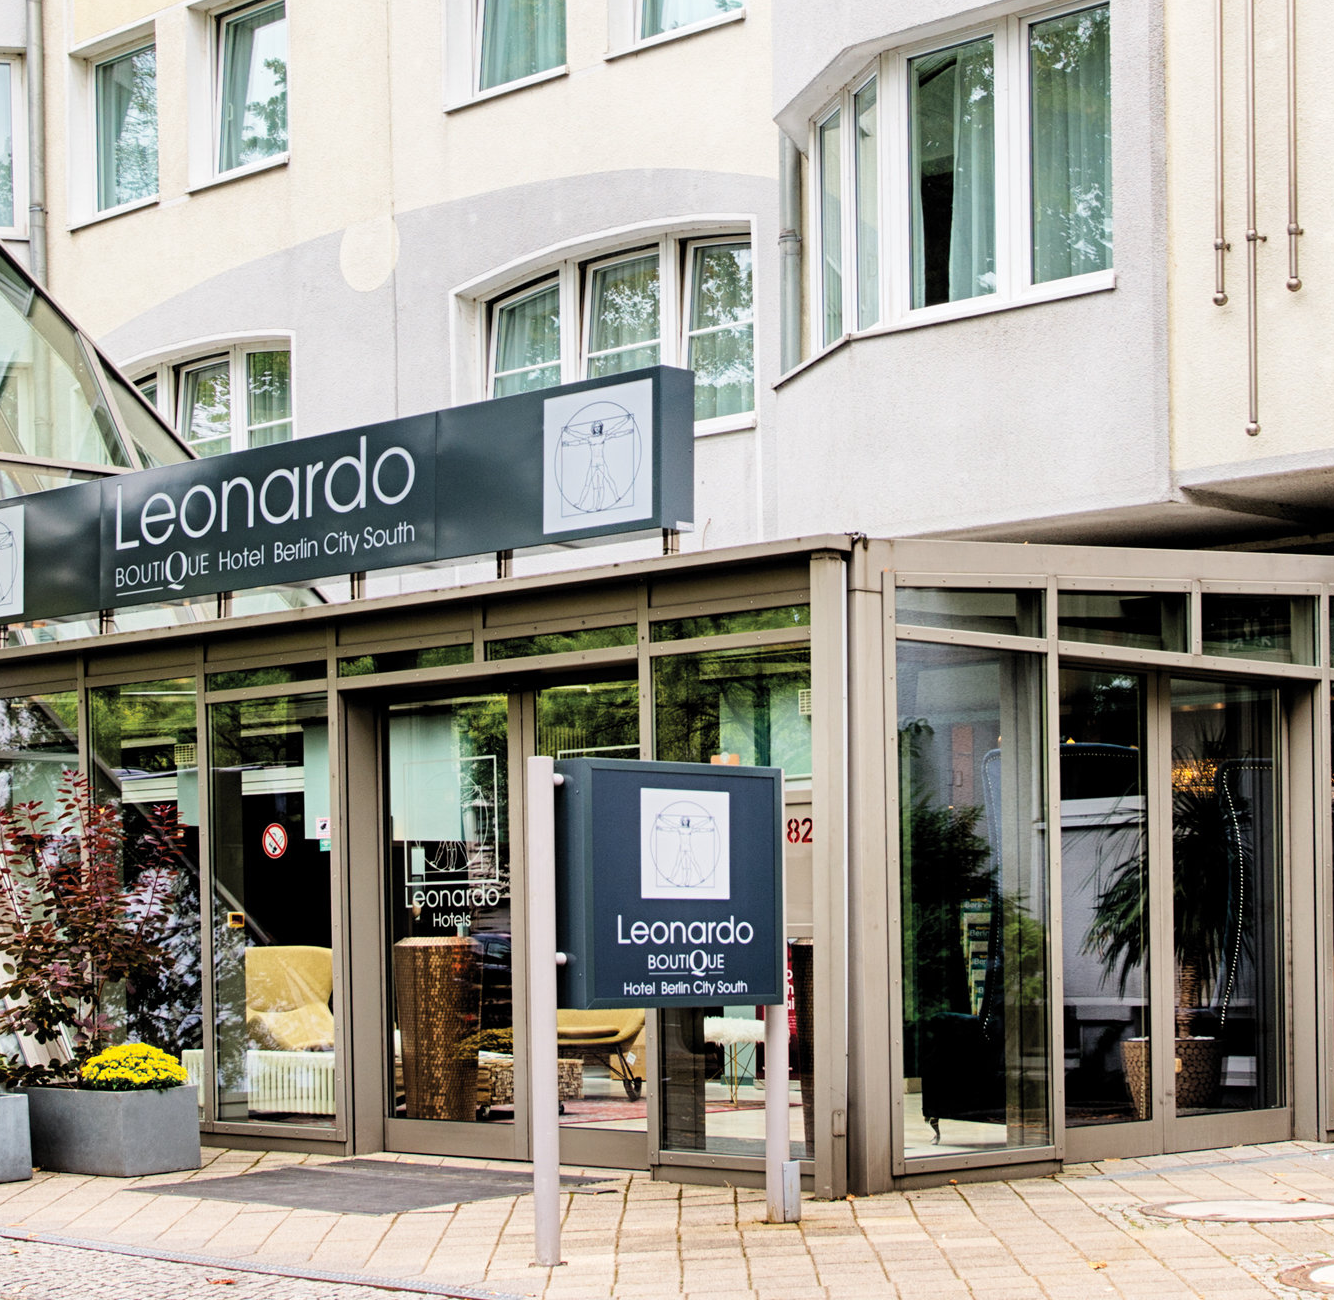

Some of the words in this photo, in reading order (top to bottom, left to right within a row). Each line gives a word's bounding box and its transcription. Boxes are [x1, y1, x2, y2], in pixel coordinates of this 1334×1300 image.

[116, 435, 416, 550] Leonardo
[115, 550, 209, 590] BOUTIQUE
[218, 544, 265, 572] Hotel
[274, 537, 318, 563] Berlin
[323, 530, 360, 555] City
[363, 521, 415, 549] South
[786, 817, 813, 844] 82
[404, 883, 500, 908] Leonardo
[432, 912, 471, 928] Hotels
[617, 914, 754, 945] Leonardo
[648, 949, 725, 977] BOUTIQUE
[623, 982, 656, 996] Hotel
[661, 981, 691, 995] Berlin
[693, 980, 715, 997] City
[717, 980, 748, 994] South
